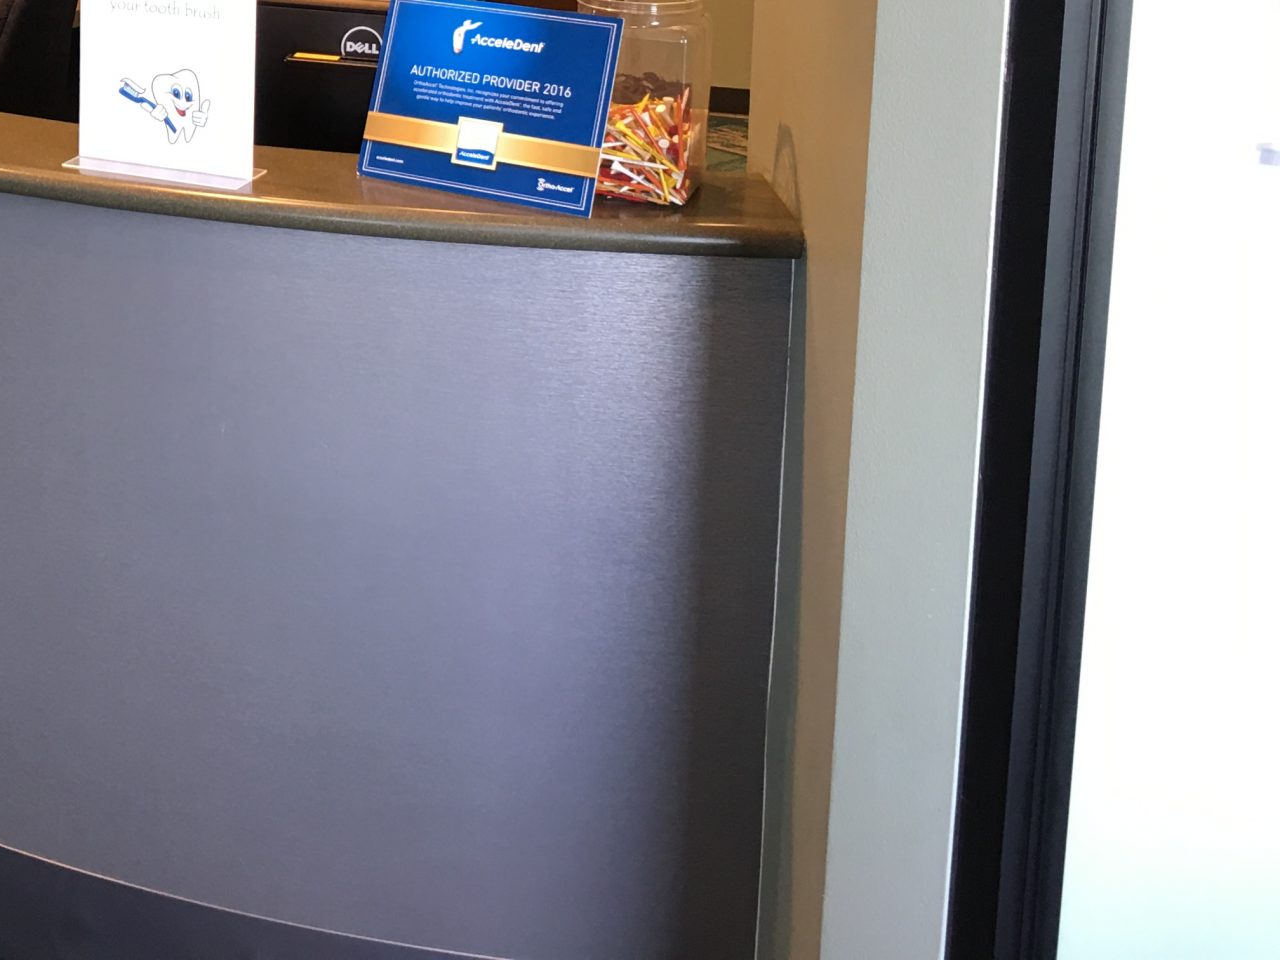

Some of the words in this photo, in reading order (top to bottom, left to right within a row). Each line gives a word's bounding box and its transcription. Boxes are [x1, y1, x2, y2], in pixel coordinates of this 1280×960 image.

[110, 0, 139, 14] your
[144, 0, 180, 15] tooth
[185, 2, 221, 21] brush
[346, 41, 380, 54] DELL
[470, 33, 545, 54] AcceleDent
[410, 64, 481, 85] AUTHORIZED
[482, 74, 541, 94] PROVIDER
[542, 83, 572, 99] 2016
